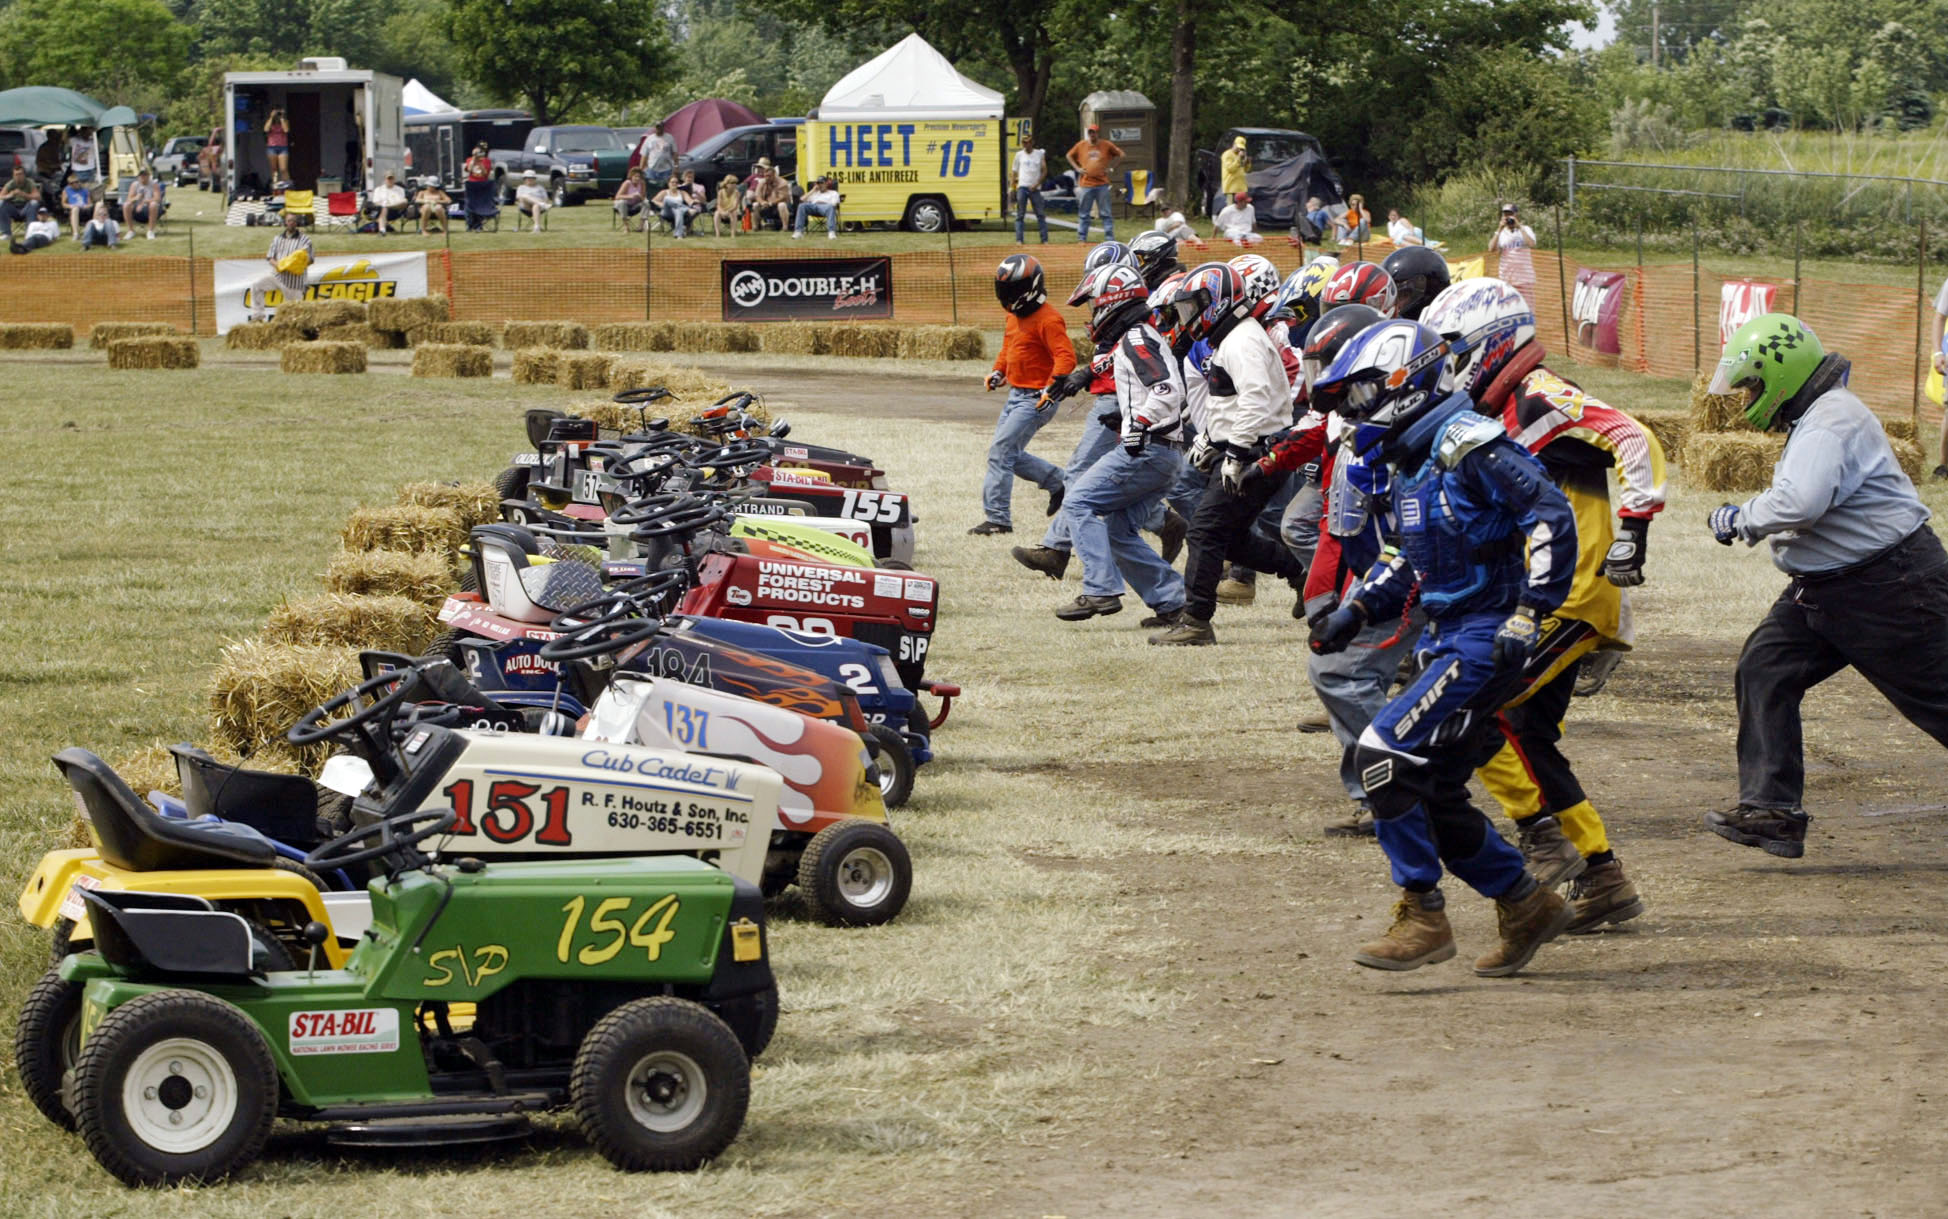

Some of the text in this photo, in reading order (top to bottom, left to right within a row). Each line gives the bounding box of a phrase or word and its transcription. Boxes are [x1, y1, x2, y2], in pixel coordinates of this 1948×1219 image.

[829, 124, 915, 167] HEET
[869, 169, 919, 184] ANTIFREEZE
[767, 277, 876, 297] DOUBLE-H
[583, 473, 598, 501] 57
[840, 491, 903, 524] 155
[758, 561, 866, 584] UNIVERSAL
[758, 574, 834, 593] FOREST
[757, 586, 865, 609] PRODUCTS
[468, 650, 482, 678] 2
[505, 654, 532, 674] AUTO
[648, 648, 713, 690] 184
[839, 663, 879, 695] 2
[1394, 658, 1461, 742] SHIFT
[663, 700, 710, 749] 137
[582, 750, 718, 788] Cub Cadet
[443, 779, 572, 847] 151
[582, 791, 599, 807] R.
[604, 794, 617, 809] F.
[622, 796, 667, 816] Houtz
[672, 799, 682, 817] &
[688, 802, 720, 822] Son,
[608, 811, 724, 841] 630-365-6551
[556, 893, 681, 966] 154
[292, 1011, 376, 1038] STA-BIL
